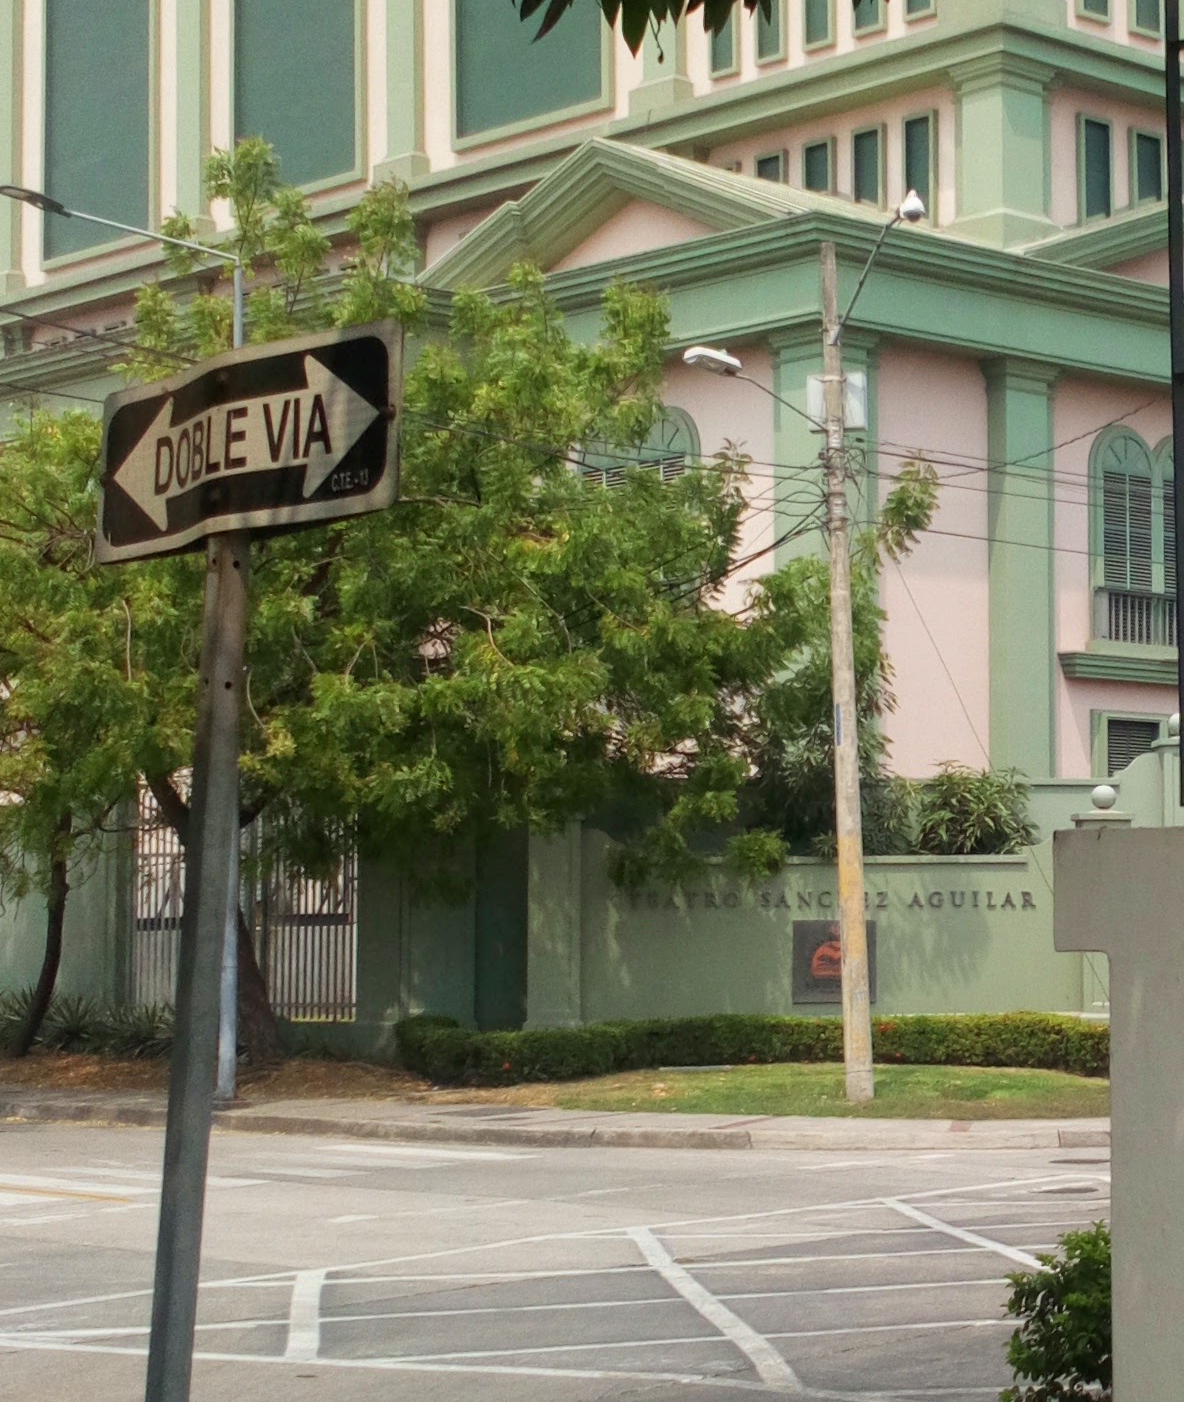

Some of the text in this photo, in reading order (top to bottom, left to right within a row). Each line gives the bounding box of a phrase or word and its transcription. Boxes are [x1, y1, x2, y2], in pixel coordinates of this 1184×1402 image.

[154, 394, 332, 496] DOBLE VIA
[760, 890, 889, 909] SANCZ
[908, 890, 1037, 910] AGUILAR
